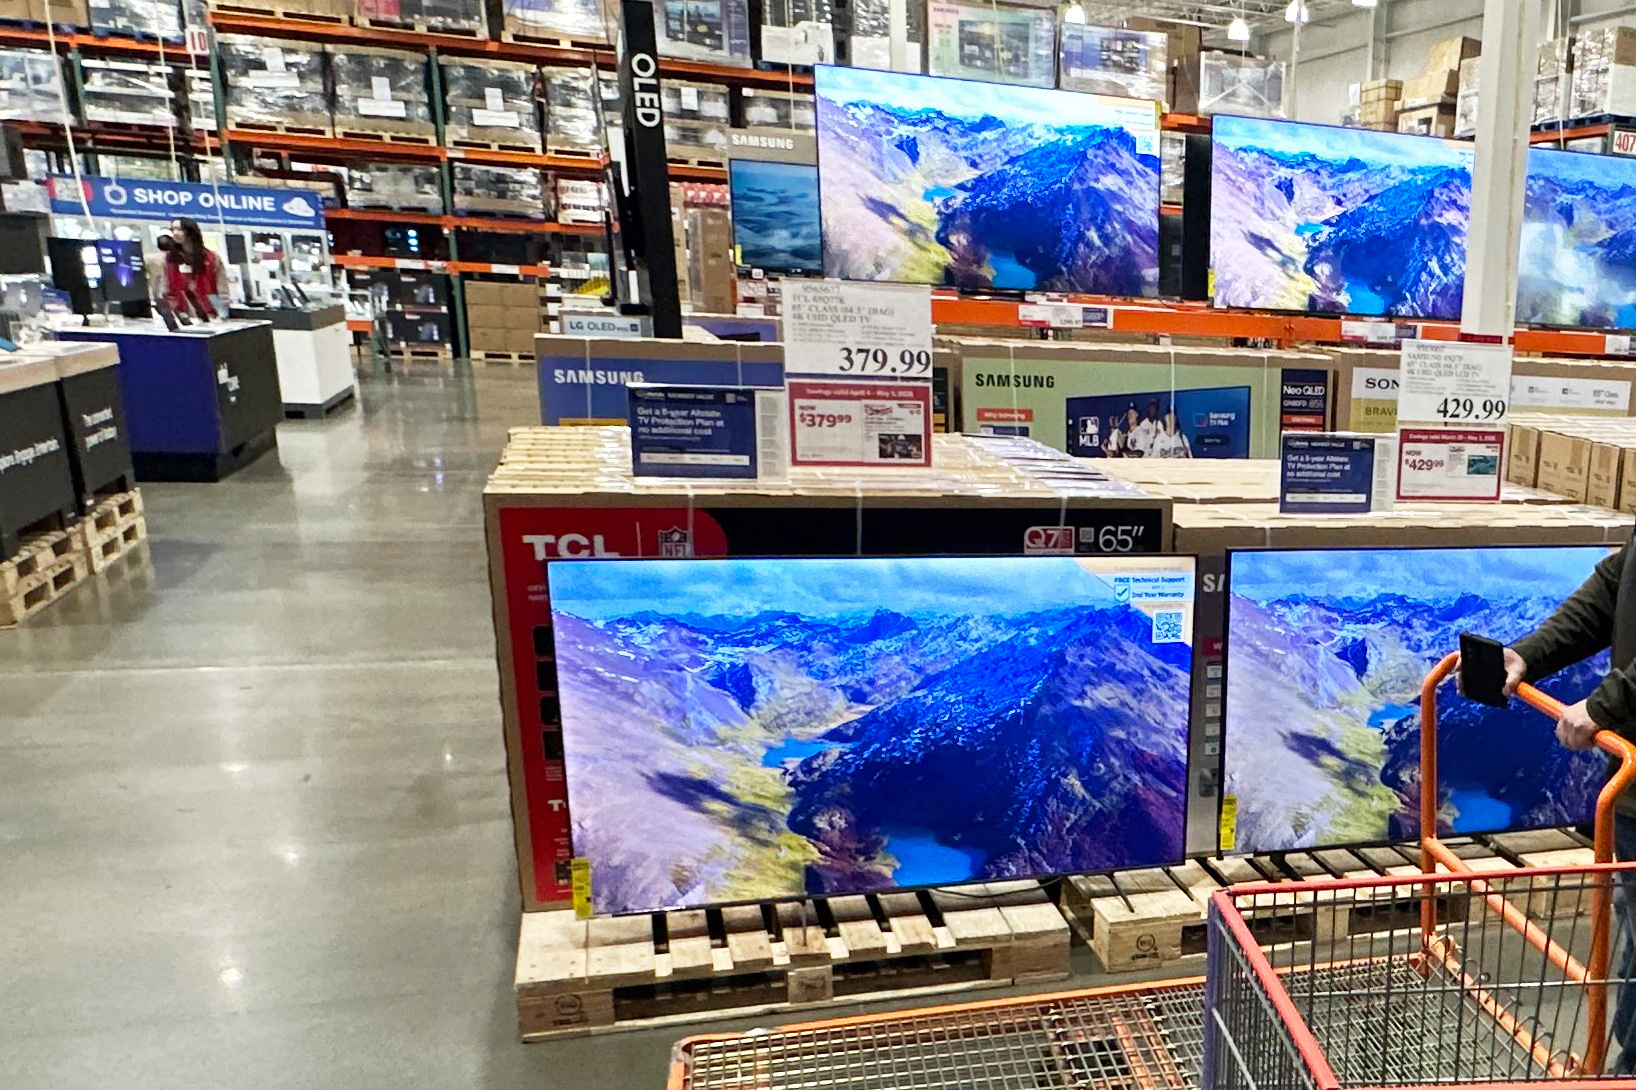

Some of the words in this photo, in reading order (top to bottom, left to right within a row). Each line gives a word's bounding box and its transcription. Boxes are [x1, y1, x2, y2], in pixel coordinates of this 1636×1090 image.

[631, 52, 661, 128] OLED
[731, 133, 794, 150] SAMSUNG
[1615, 132, 1636, 152] 407
[133, 187, 193, 207] SHOP
[199, 193, 276, 212] ONLINE
[569, 321, 584, 330] LG
[587, 321, 616, 331] OLED
[838, 347, 931, 374] 379.99
[554, 368, 645, 384] SAMSUNG
[975, 372, 1056, 389] SAMSUNG
[1364, 378, 1400, 390] SON
[1283, 385, 1301, 395] Neo
[1303, 385, 1325, 396] QLED
[637, 406, 653, 415] Get
[1209, 412, 1236, 421] Samsung
[1364, 406, 1398, 416] BRAV
[1436, 397, 1506, 421] 429.99
[638, 416, 650, 424] TV
[1078, 435, 1100, 447] MLB
[521, 533, 620, 560] TCL
[1025, 527, 1060, 549] Q7
[1099, 525, 1145, 552] 65"
